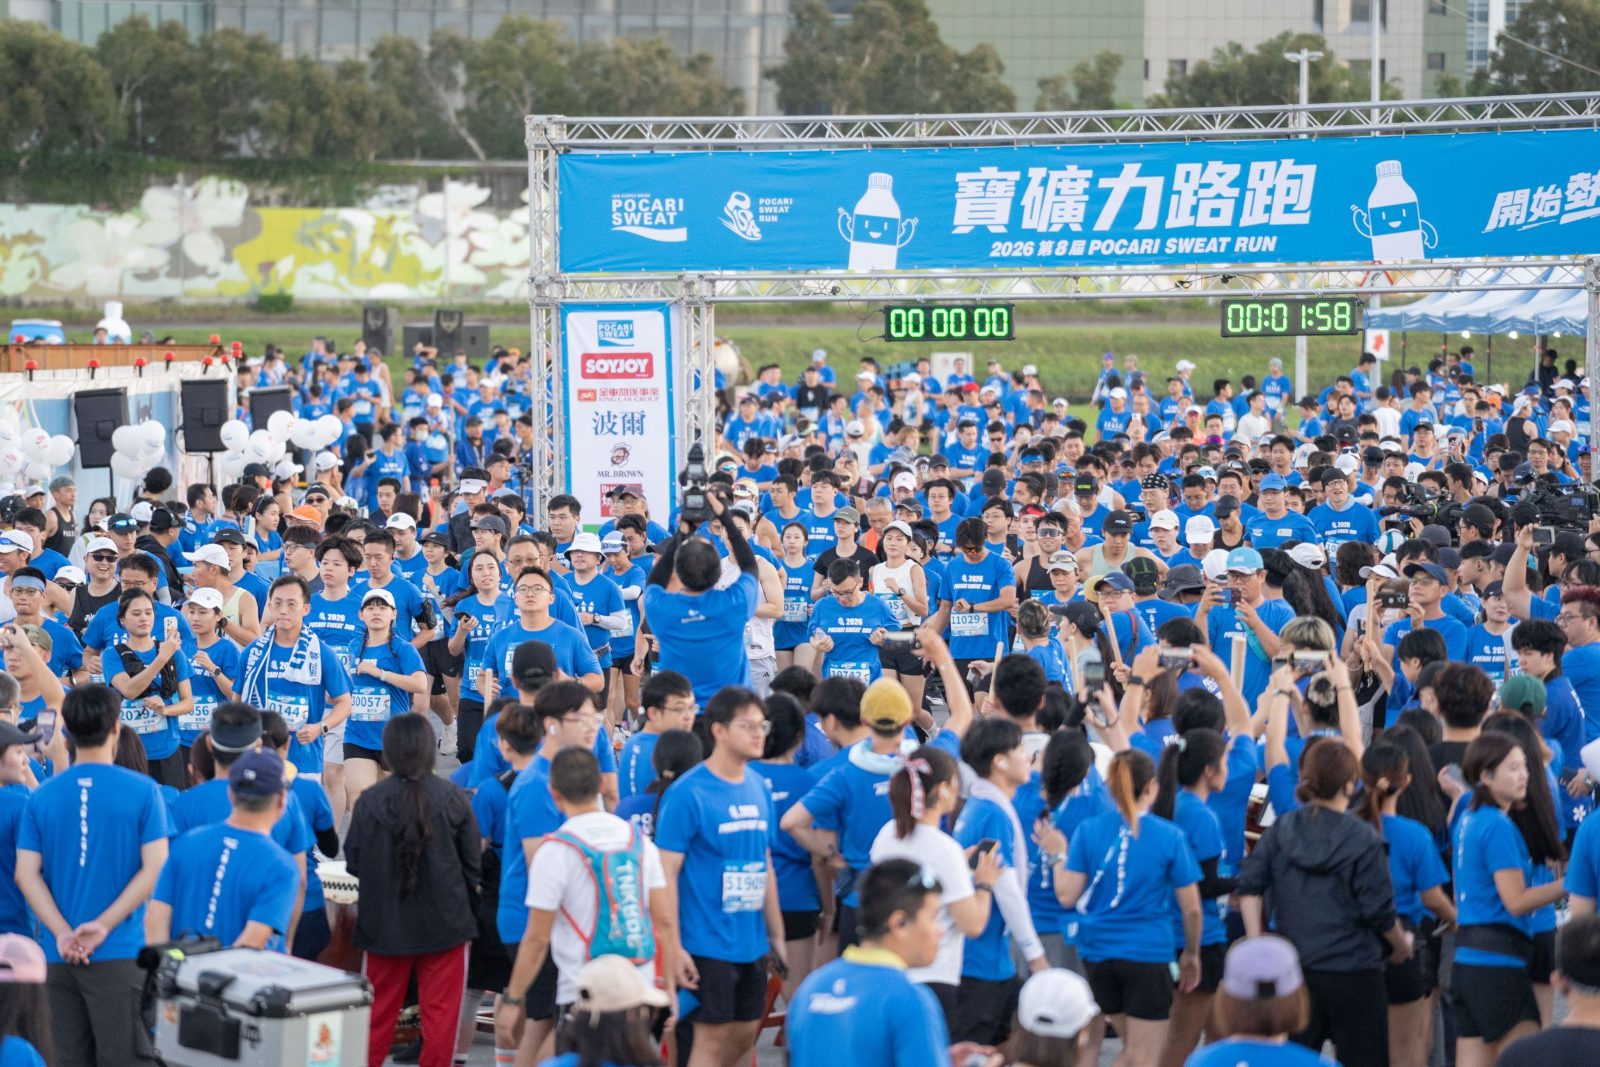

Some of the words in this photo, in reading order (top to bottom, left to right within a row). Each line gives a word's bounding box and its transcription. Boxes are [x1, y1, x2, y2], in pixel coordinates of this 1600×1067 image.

[952, 159, 1316, 234] 寶礦力路跑
[612, 198, 684, 212] POCARI
[612, 212, 677, 225] SWEAT
[989, 241, 1034, 257] 2026
[1088, 239, 1160, 255] POCARI
[1165, 237, 1231, 254] SWEAT
[1238, 236, 1278, 252] RUN
[586, 359, 649, 373] SOYJOY
[593, 410, 646, 436] 波爾
[952, 615, 980, 624] 11029
[351, 697, 381, 707] 30057
